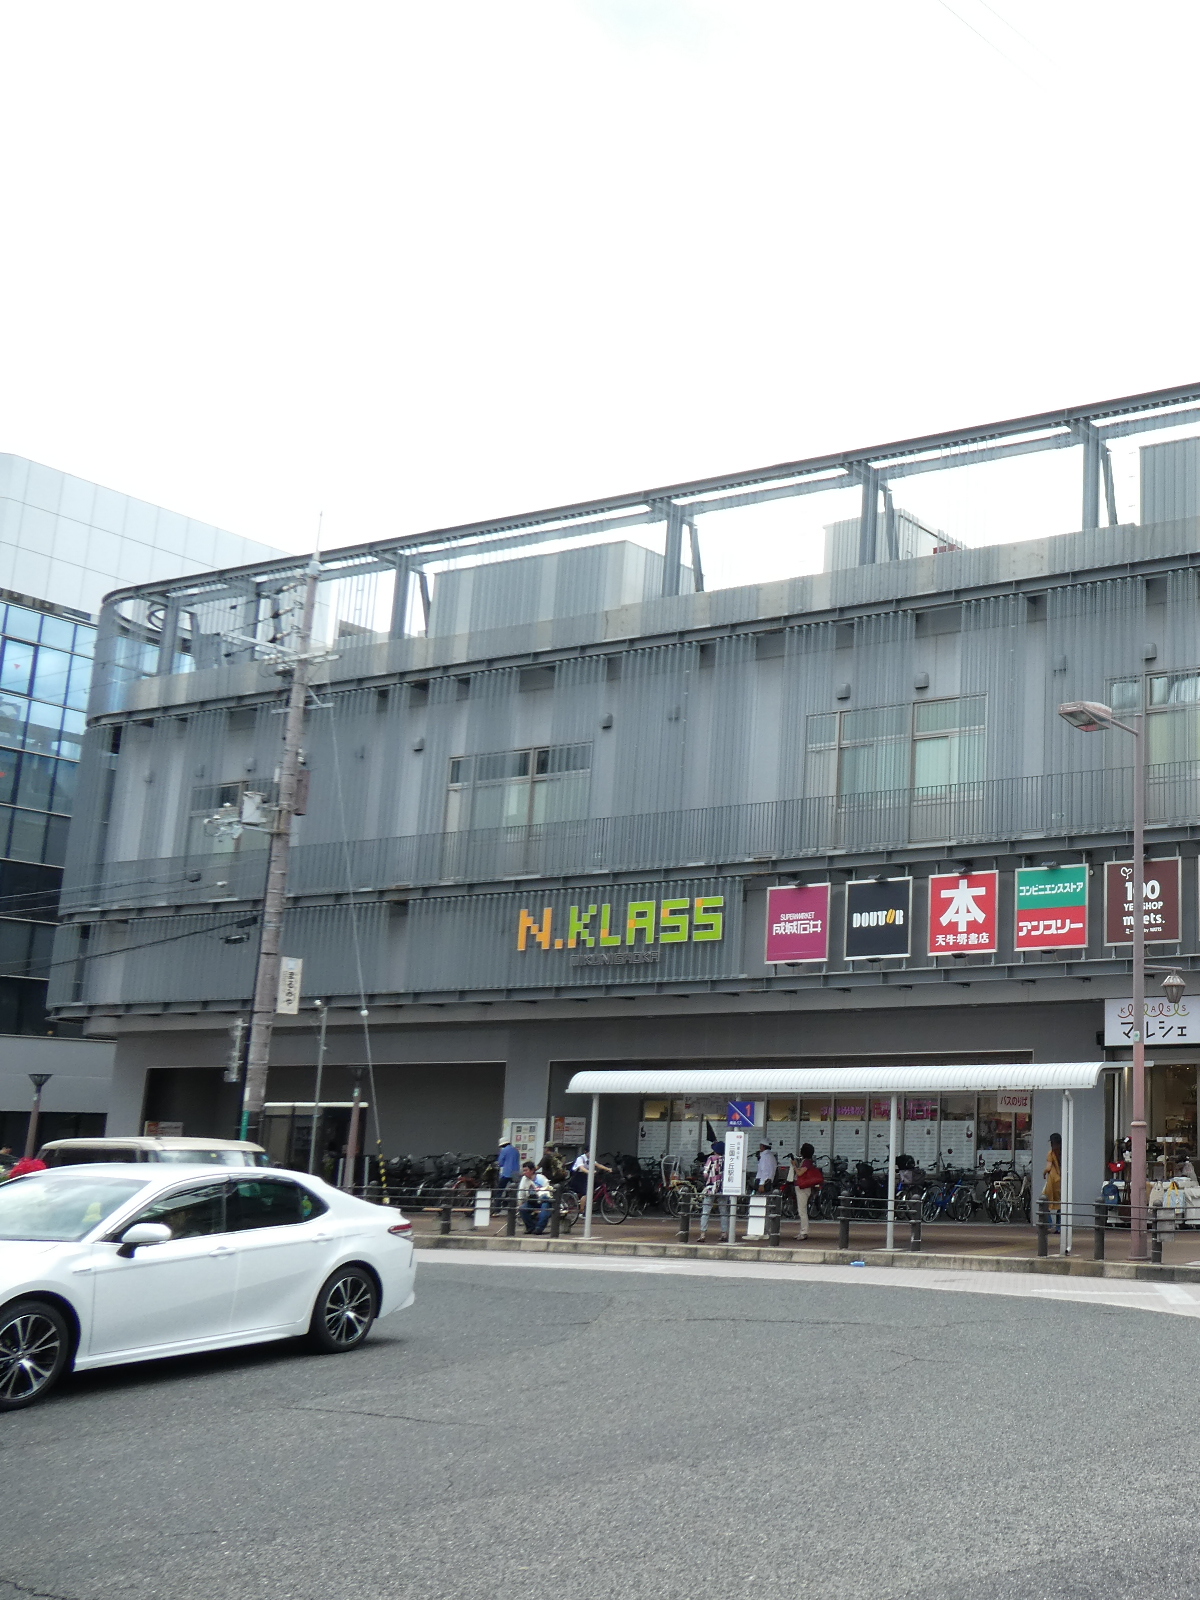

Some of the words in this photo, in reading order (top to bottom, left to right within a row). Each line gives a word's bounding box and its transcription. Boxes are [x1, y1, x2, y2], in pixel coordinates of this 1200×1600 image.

[1019, 881, 1084, 896] コンビニエンスストア
[1125, 879, 1161, 901] 10
[939, 879, 986, 932] 本
[517, 896, 724, 951] N.KLASS
[780, 911, 815, 921] SUPERMARKET
[852, 908, 904, 928] DOUTOR
[1122, 912, 1166, 926] mets.
[773, 919, 822, 936] 成城石井
[1018, 918, 1084, 937] アンスリー
[935, 932, 990, 947] 天牛堺書店
[1000, 1095, 1028, 1107] バスのりば
[745, 1103, 752, 1117] 1
